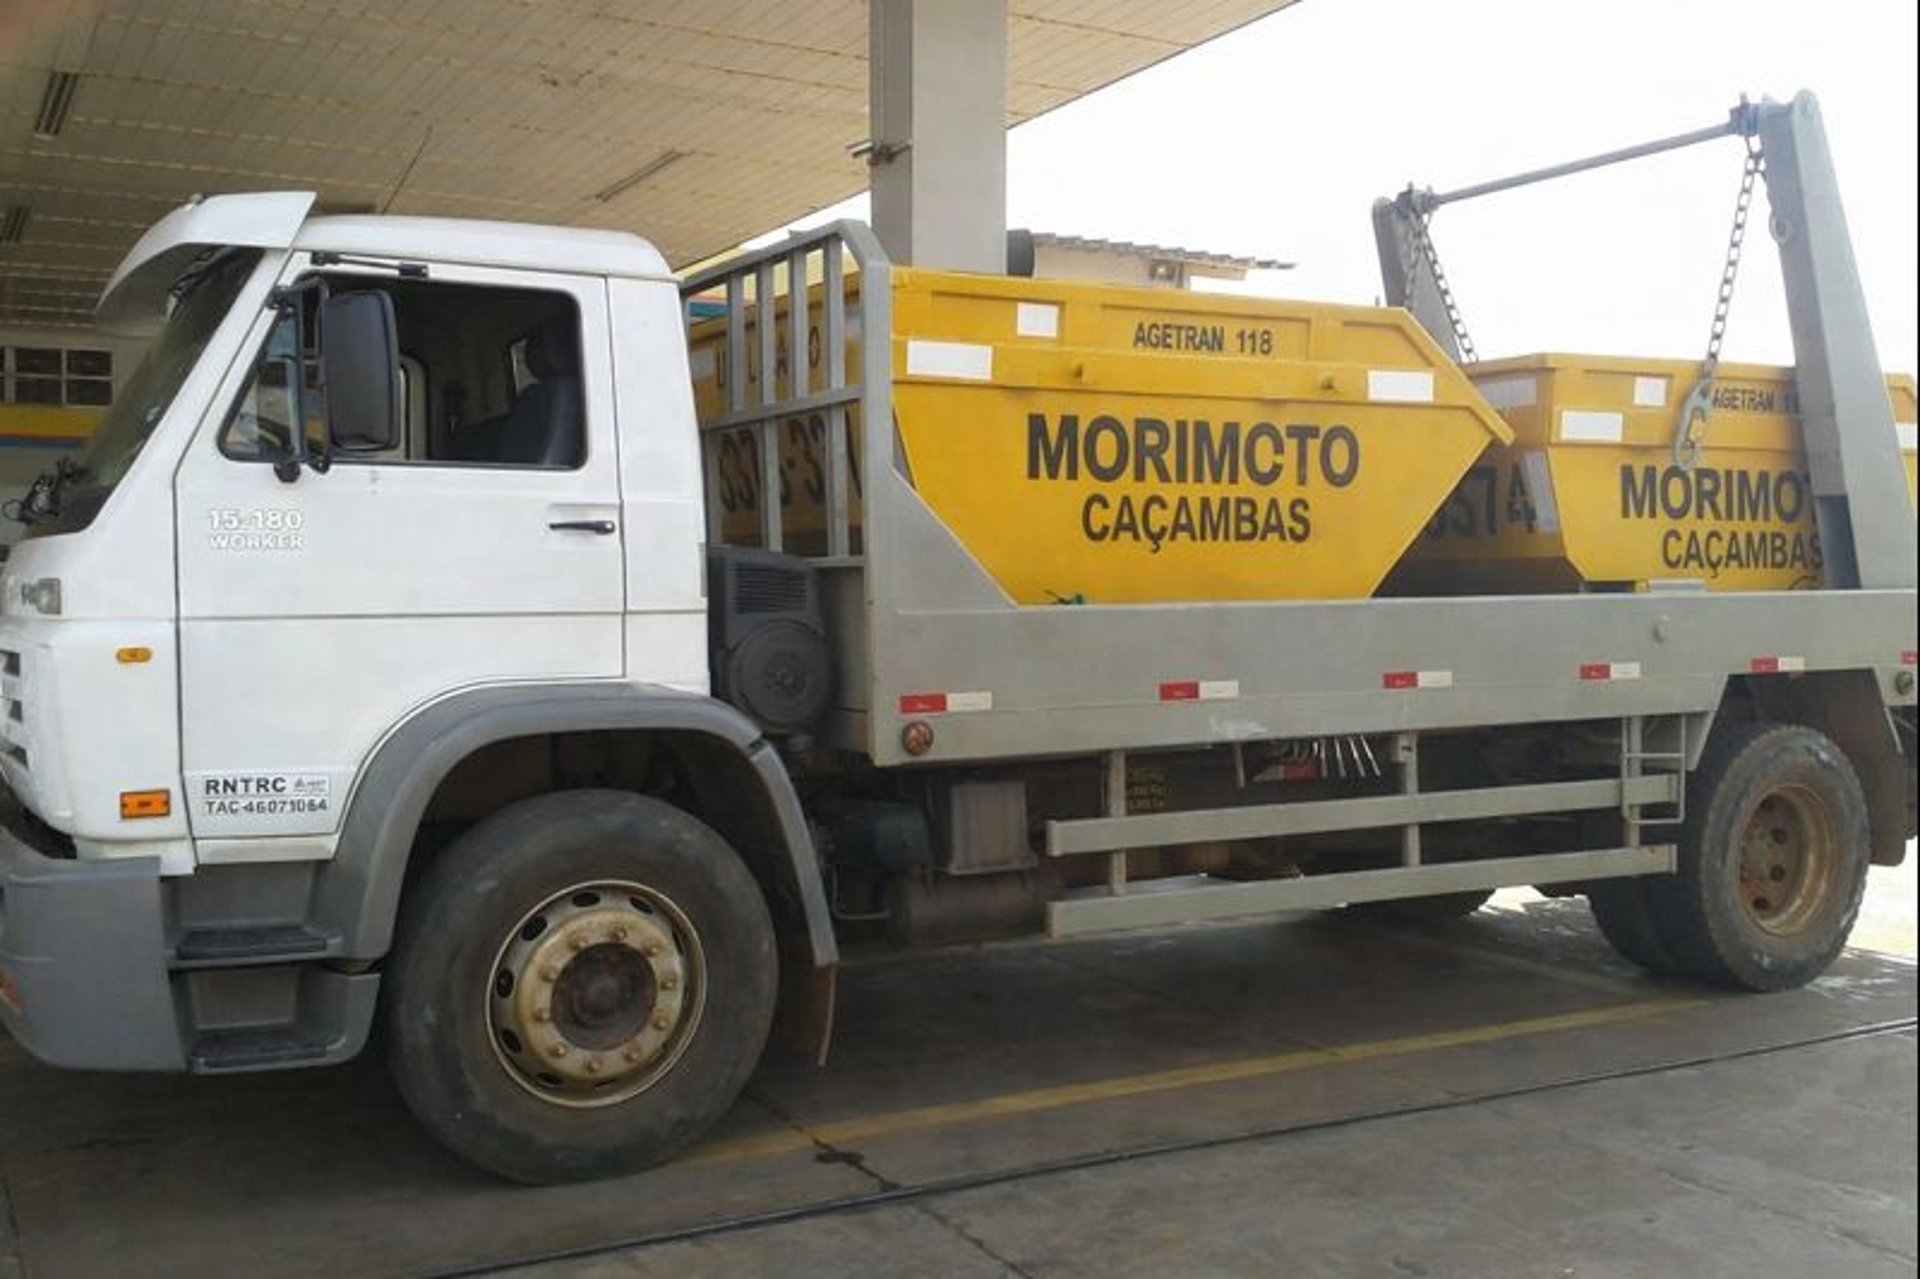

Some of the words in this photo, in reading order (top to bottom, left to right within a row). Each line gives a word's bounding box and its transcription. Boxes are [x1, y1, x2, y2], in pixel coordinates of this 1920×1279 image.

[1133, 322, 1225, 352] AGETRAN
[1236, 328, 1273, 356] 118
[1712, 387, 1775, 411] AGETRAN
[1081, 492, 1312, 555] CAÇAMBAS
[210, 533, 303, 550] WORKER
[1662, 529, 1824, 578] CAÇAMBAS
[205, 776, 287, 795] RNTRC
